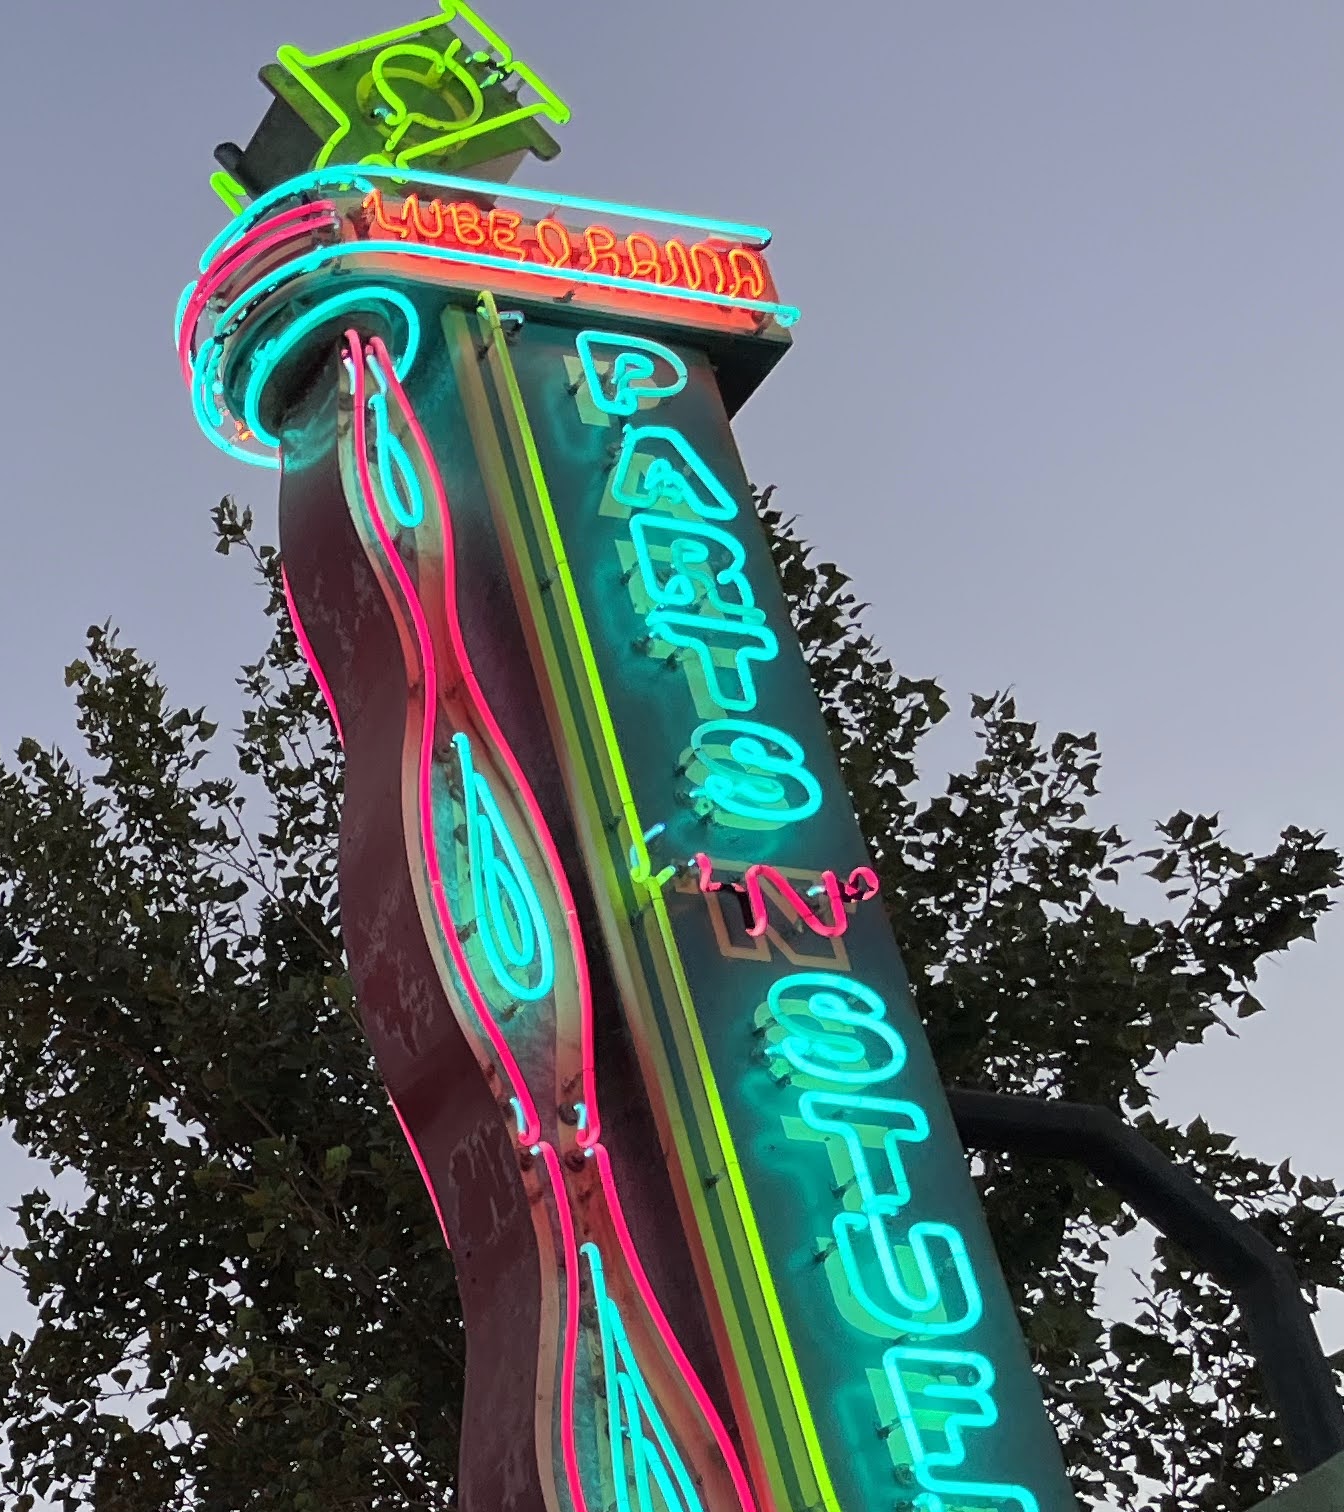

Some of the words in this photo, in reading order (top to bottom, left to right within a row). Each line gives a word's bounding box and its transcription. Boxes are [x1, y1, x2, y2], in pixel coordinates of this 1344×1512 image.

[362, 188, 525, 262] LUBE
[583, 224, 766, 298] RAMA
[568, 329, 822, 828] PARTS
